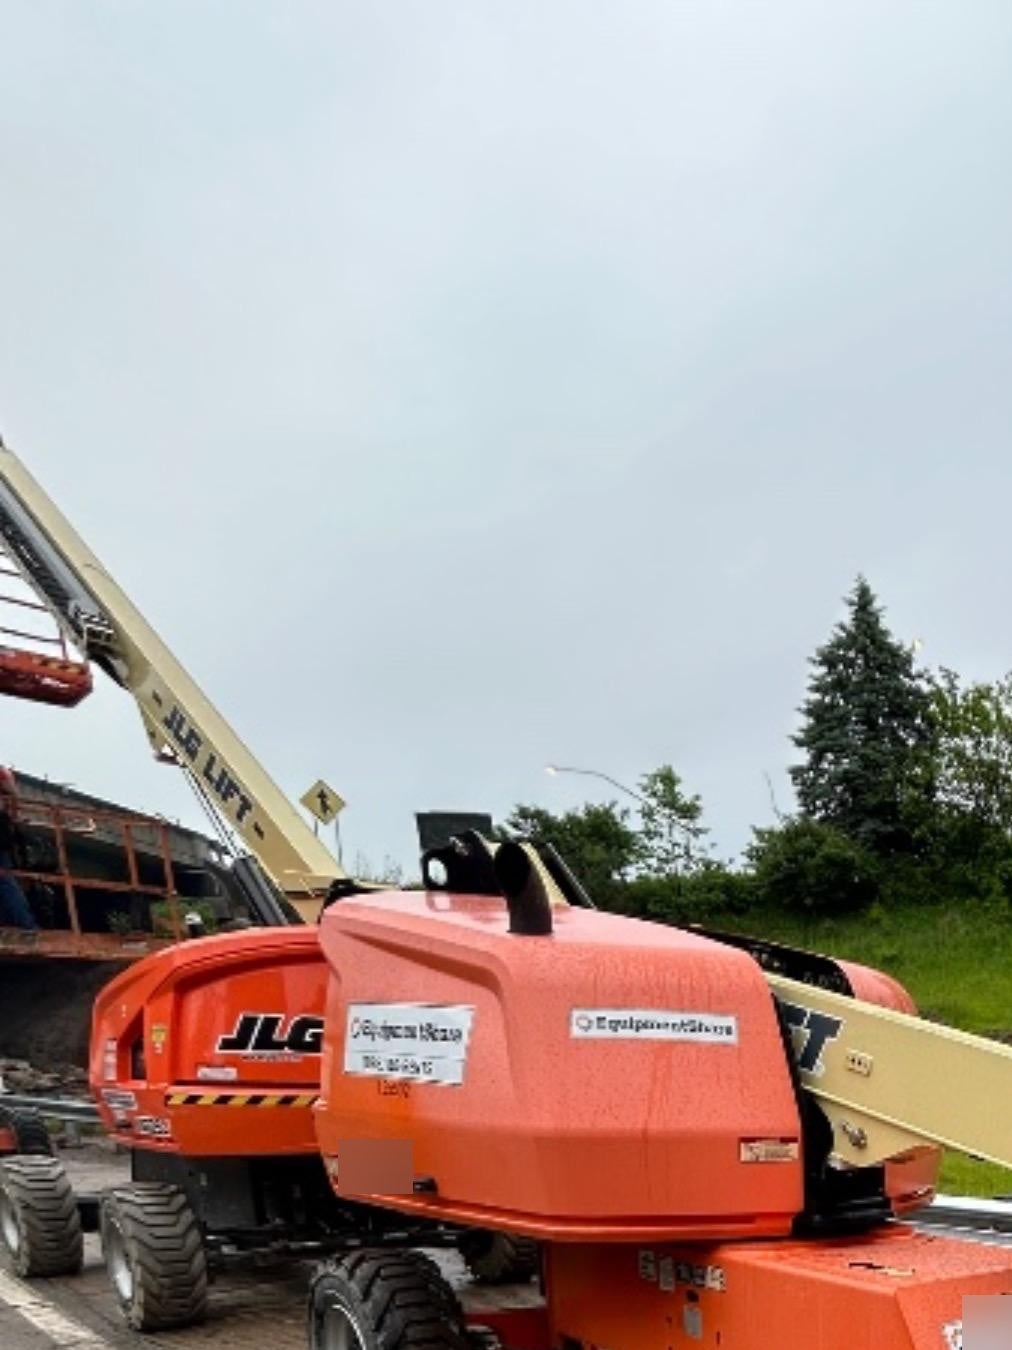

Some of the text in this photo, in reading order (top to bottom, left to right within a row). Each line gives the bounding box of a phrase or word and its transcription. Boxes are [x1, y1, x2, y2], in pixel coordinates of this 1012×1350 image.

[164, 705, 252, 822] JLG LIFT
[216, 1013, 324, 1053] JLG
